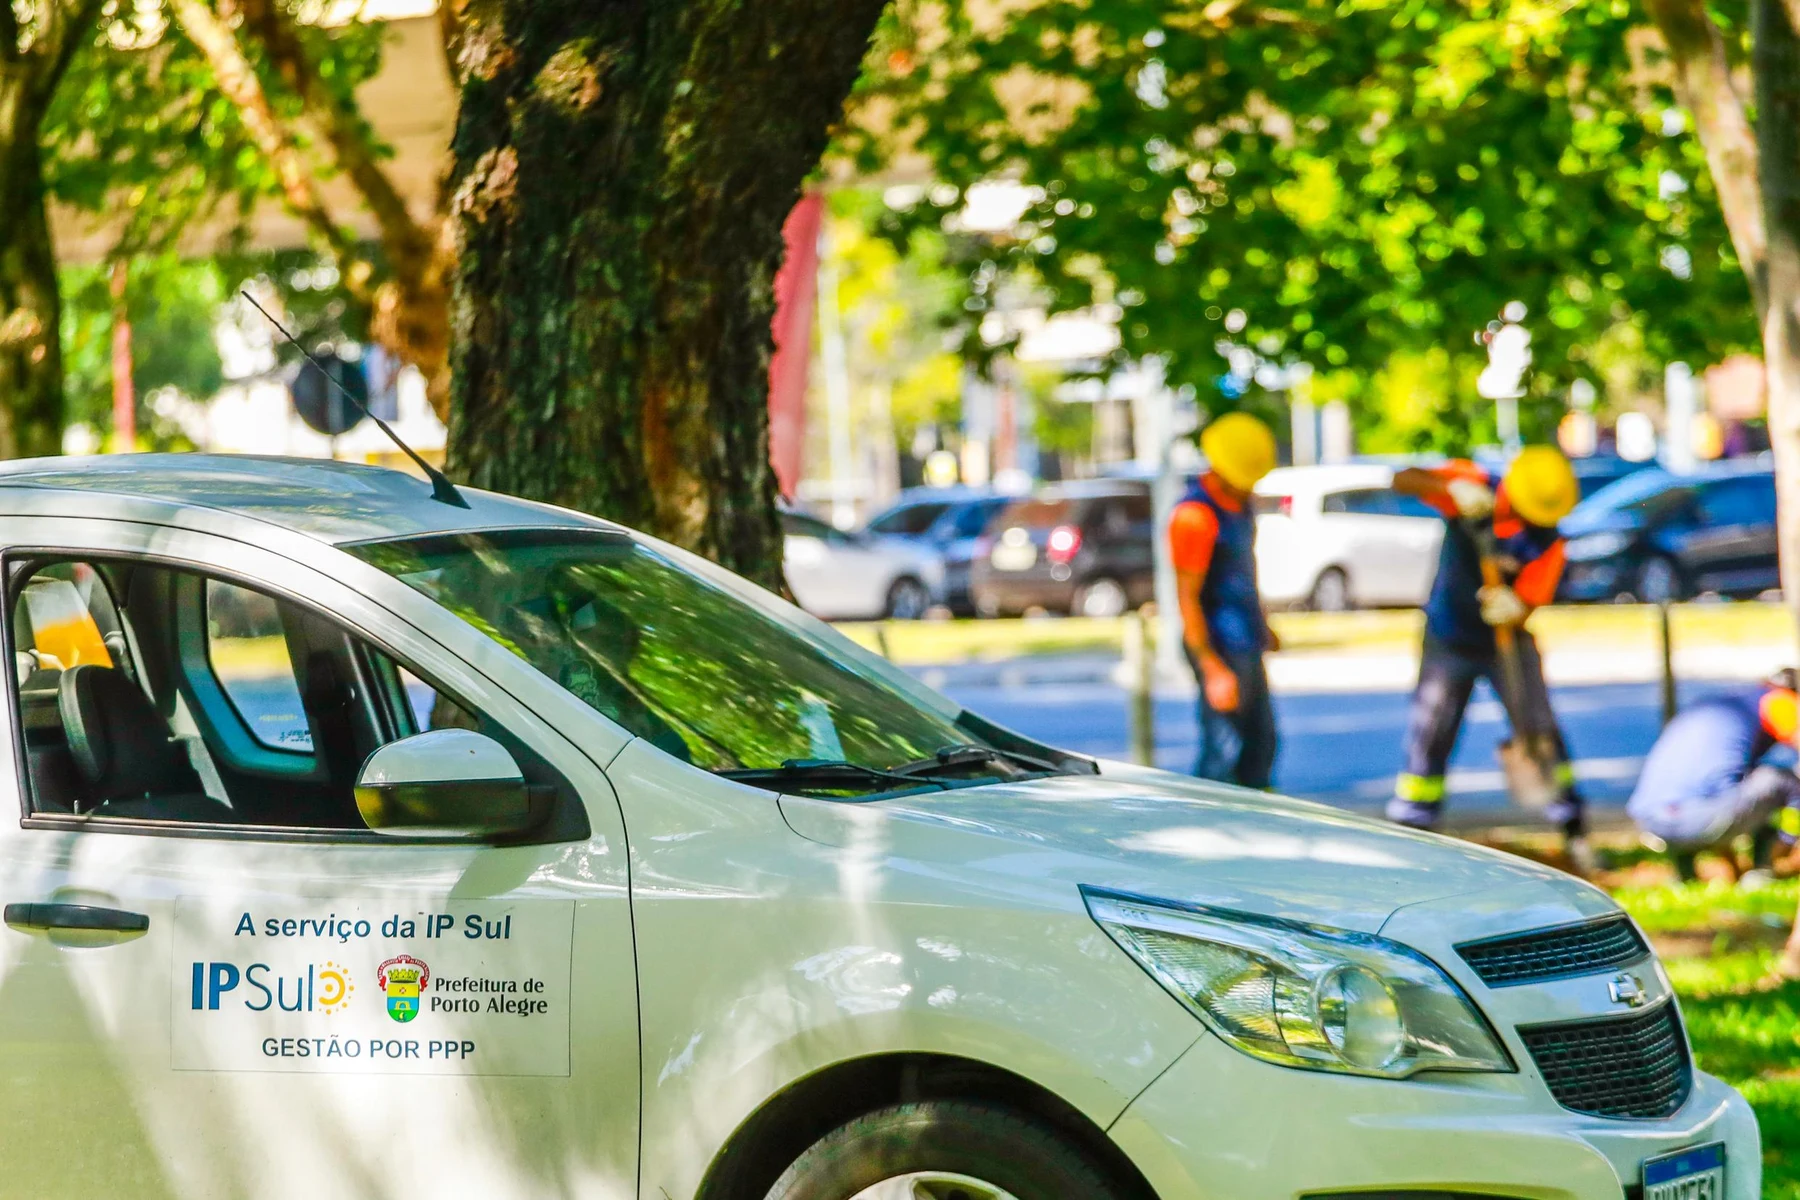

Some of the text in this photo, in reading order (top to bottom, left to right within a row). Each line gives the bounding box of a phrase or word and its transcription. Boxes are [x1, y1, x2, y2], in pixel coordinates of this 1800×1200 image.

[235, 912, 511, 943] A serviço da IP Sul
[434, 977, 544, 993] Prefeitura de
[431, 995, 548, 1017] Porto Alegre
[261, 1034, 475, 1060] GESTÃO POR PPP
